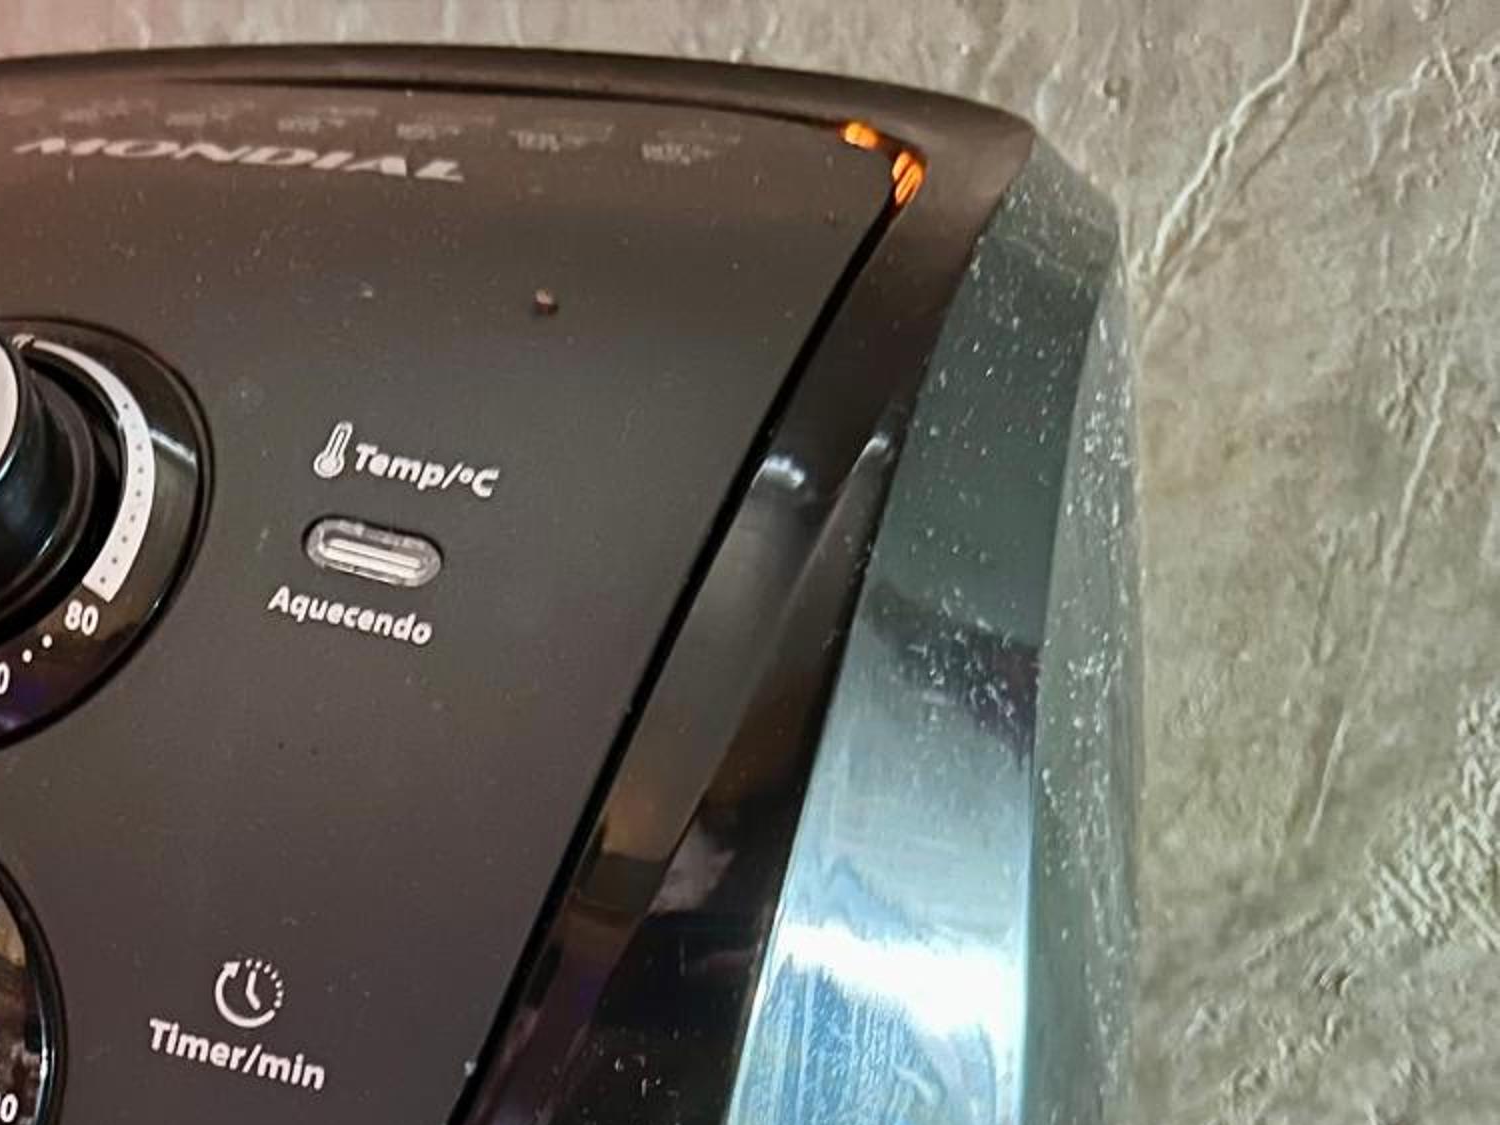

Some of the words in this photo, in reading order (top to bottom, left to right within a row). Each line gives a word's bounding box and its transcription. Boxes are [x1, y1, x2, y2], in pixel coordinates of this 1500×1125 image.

[12, 137, 466, 181] MONDIAL
[65, 600, 98, 637] 80
[267, 585, 432, 645] Aquecendo
[149, 1017, 326, 1091] Timer/min
